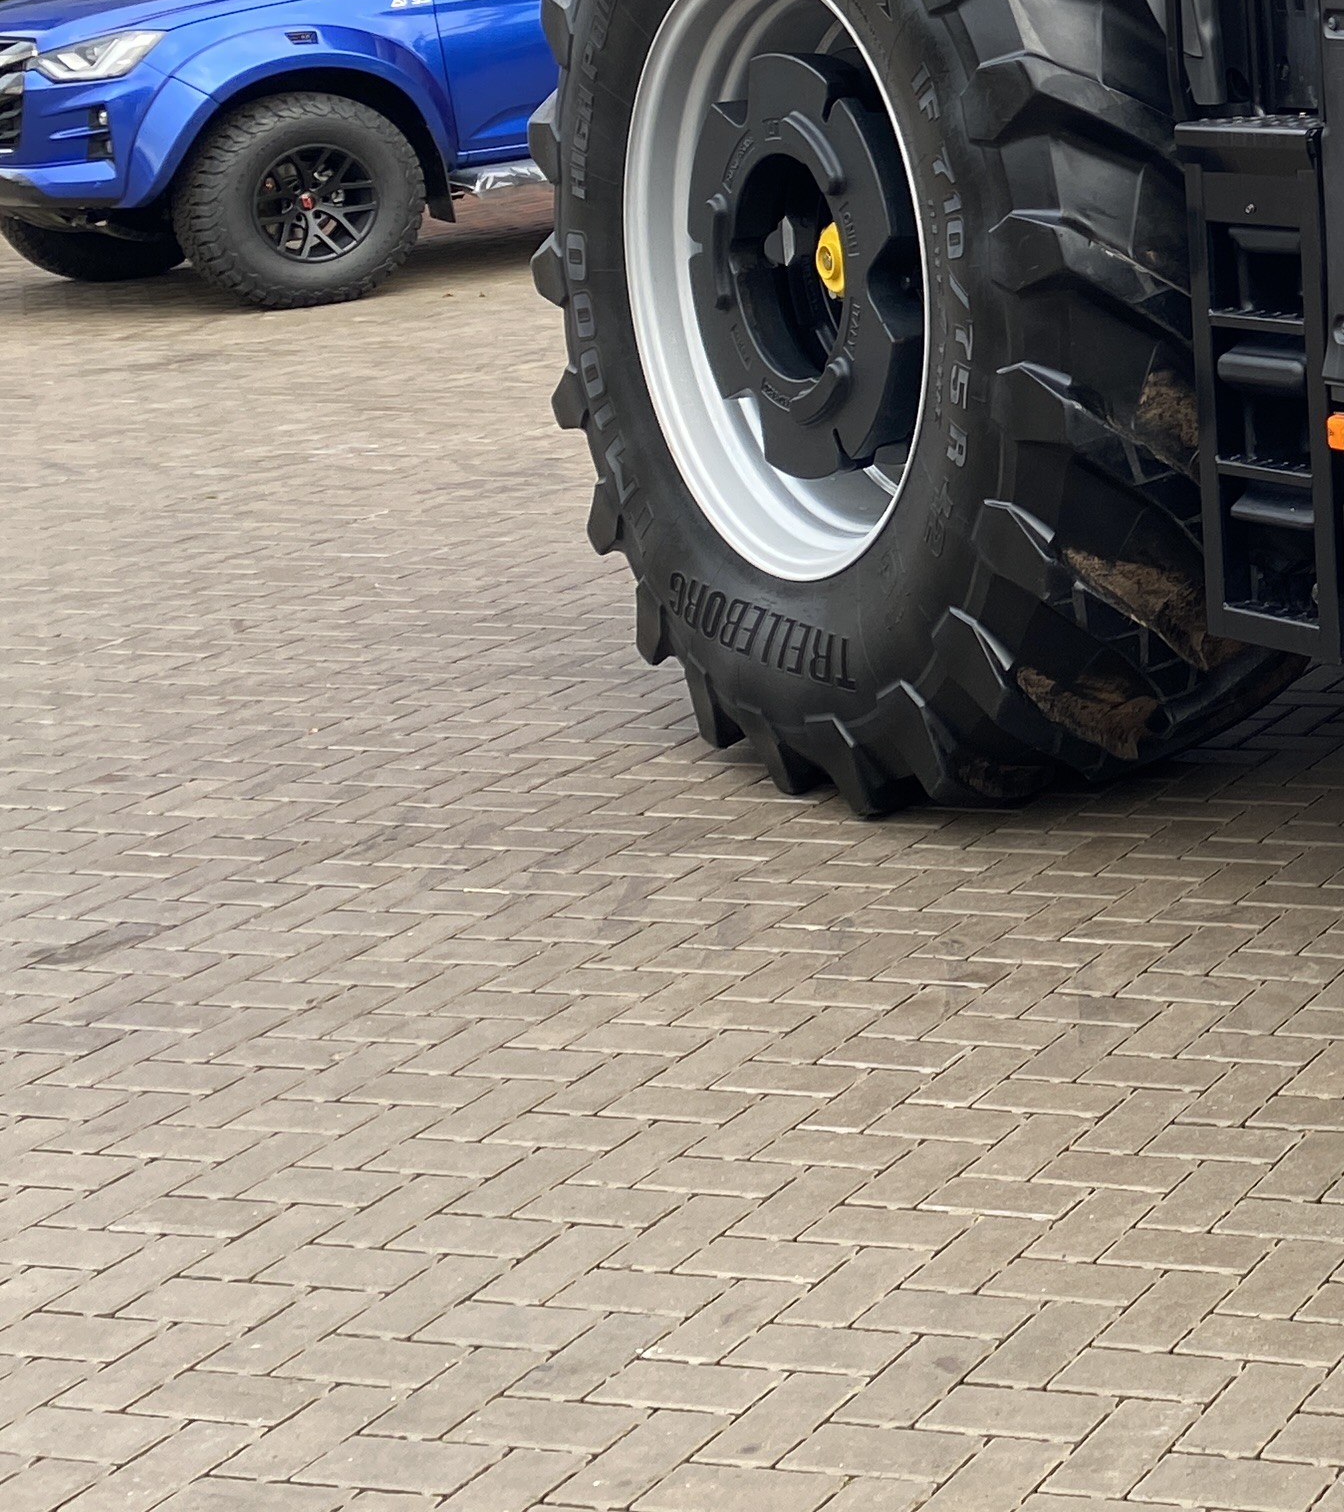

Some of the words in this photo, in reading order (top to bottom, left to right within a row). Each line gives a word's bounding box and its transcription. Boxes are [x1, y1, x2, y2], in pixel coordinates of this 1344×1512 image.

[570, 84, 595, 201] HIGH
[911, 61, 941, 121] IF
[932, 140, 973, 410] 710/75
[669, 571, 858, 693] TRELLEBORG
